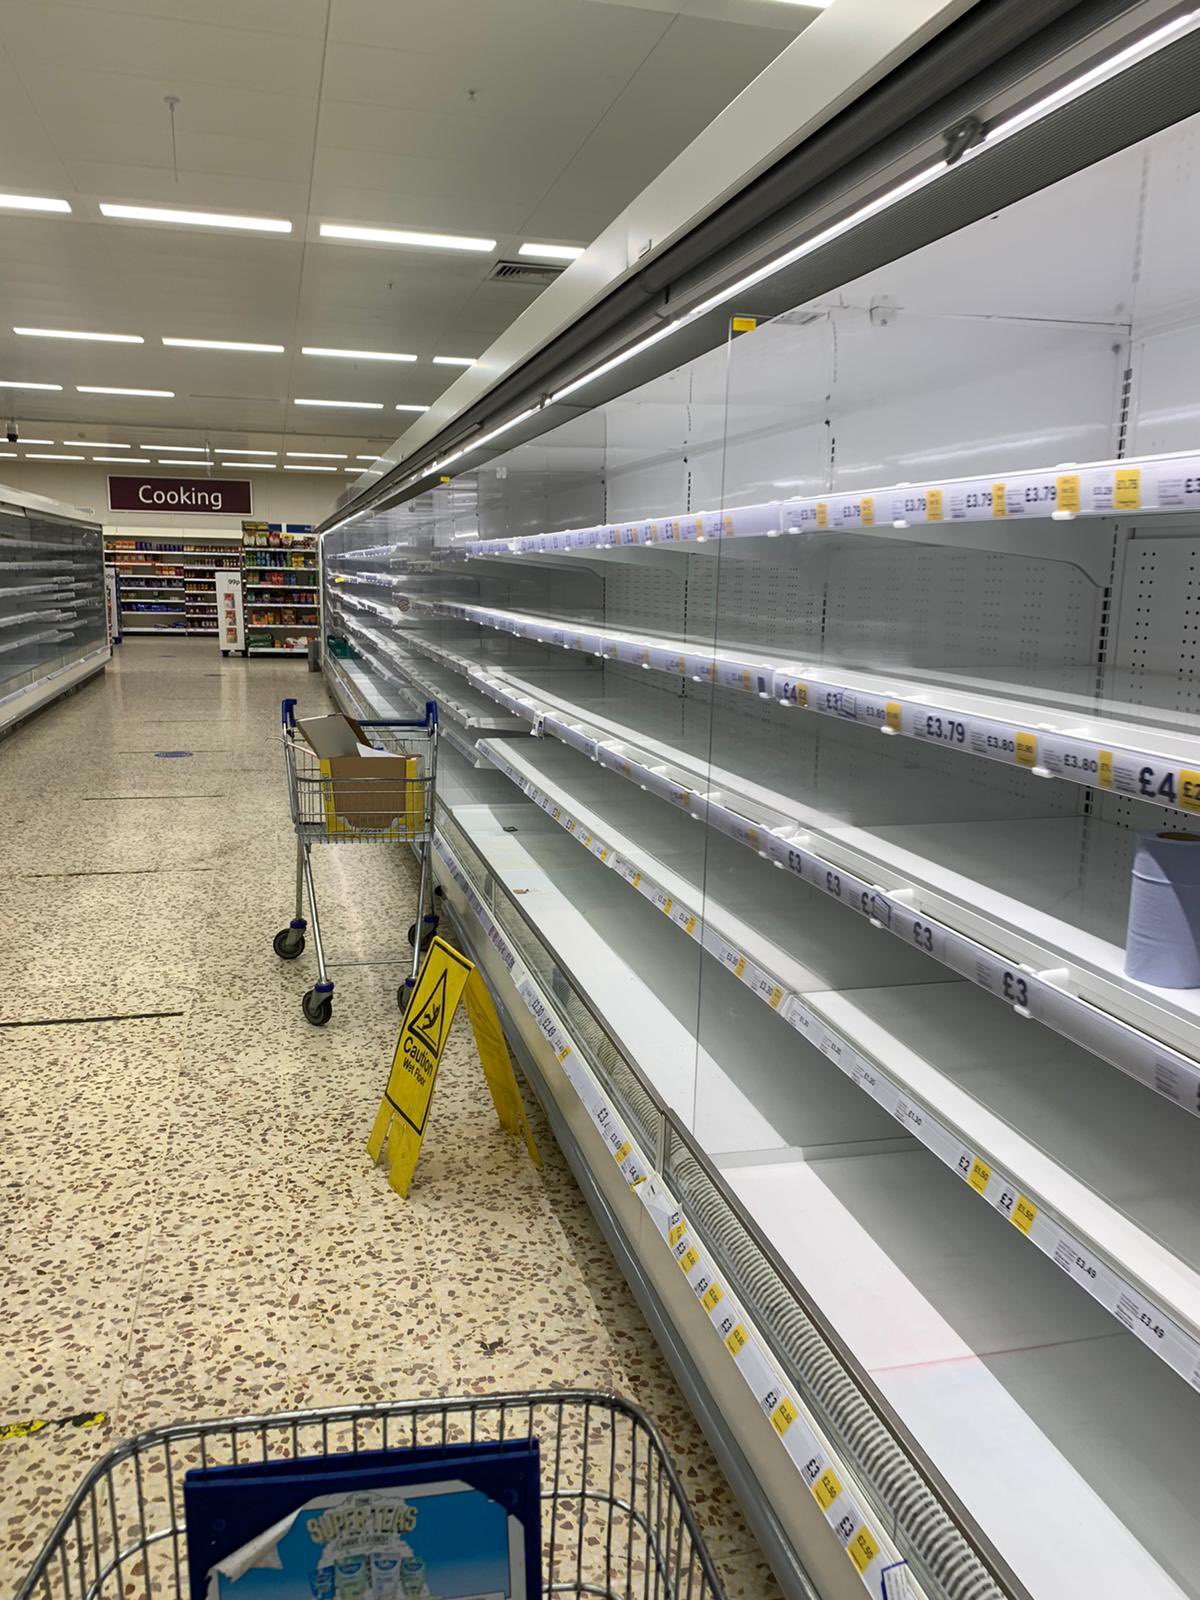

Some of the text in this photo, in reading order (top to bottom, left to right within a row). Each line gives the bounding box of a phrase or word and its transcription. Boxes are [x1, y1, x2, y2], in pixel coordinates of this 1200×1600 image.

[138, 484, 223, 510] Cooking
[1025, 486, 1057, 502] £3.79
[926, 715, 966, 743] £3.79
[987, 735, 1015, 753] £3.80
[1063, 753, 1098, 773] £3.80
[1138, 766, 1177, 803] £4
[788, 850, 802, 874] £3
[826, 871, 841, 897] £3
[913, 921, 933, 952] £3
[1001, 970, 1029, 1007] £3
[403, 1036, 433, 1078] Caution
[402, 1056, 426, 1087] Wet Floor
[958, 1155, 971, 1173] £2
[999, 1192, 1014, 1211] £2
[698, 1277, 709, 1292] £3
[721, 1318, 733, 1333] £3
[765, 1391, 778, 1409] £3
[806, 1458, 820, 1478] £3
[822, 1475, 837, 1499] £2.50
[840, 1515, 855, 1538] £3
[856, 1534, 874, 1560] £2.50
